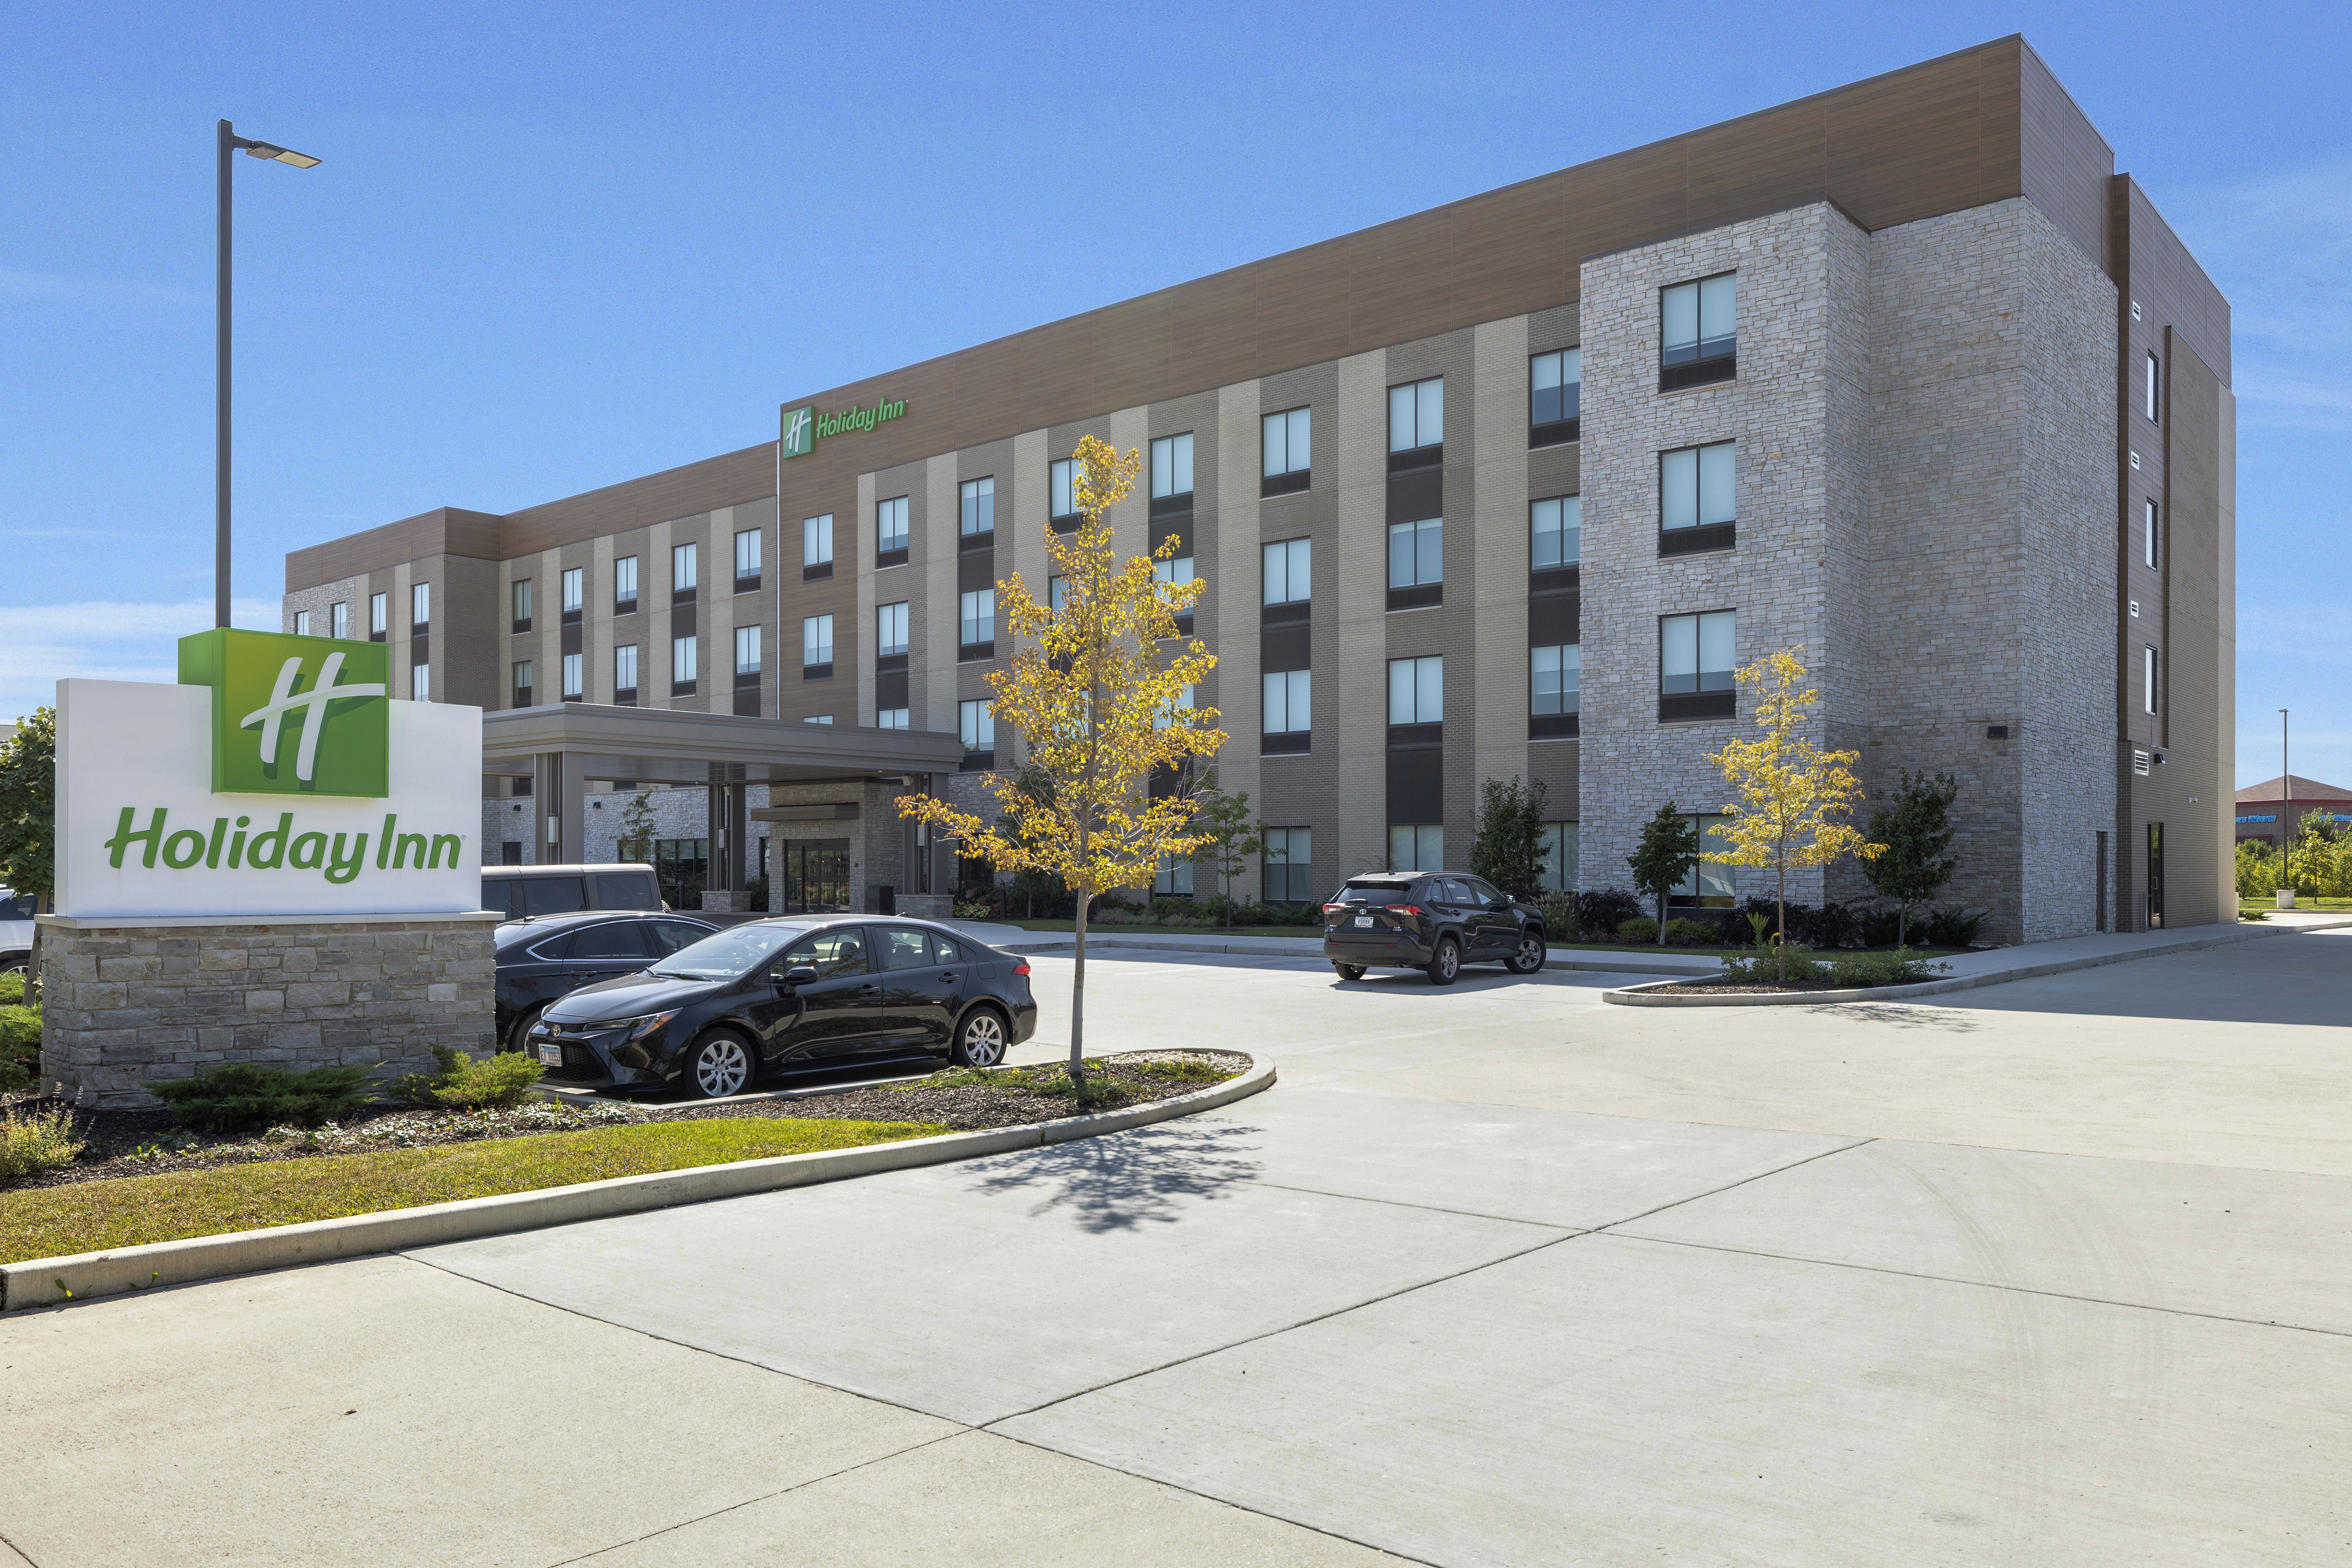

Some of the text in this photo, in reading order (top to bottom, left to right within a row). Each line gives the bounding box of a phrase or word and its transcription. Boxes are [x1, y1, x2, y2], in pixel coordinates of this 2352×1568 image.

[816, 397, 907, 439] Holiday Inn
[104, 807, 368, 884] Holiday
